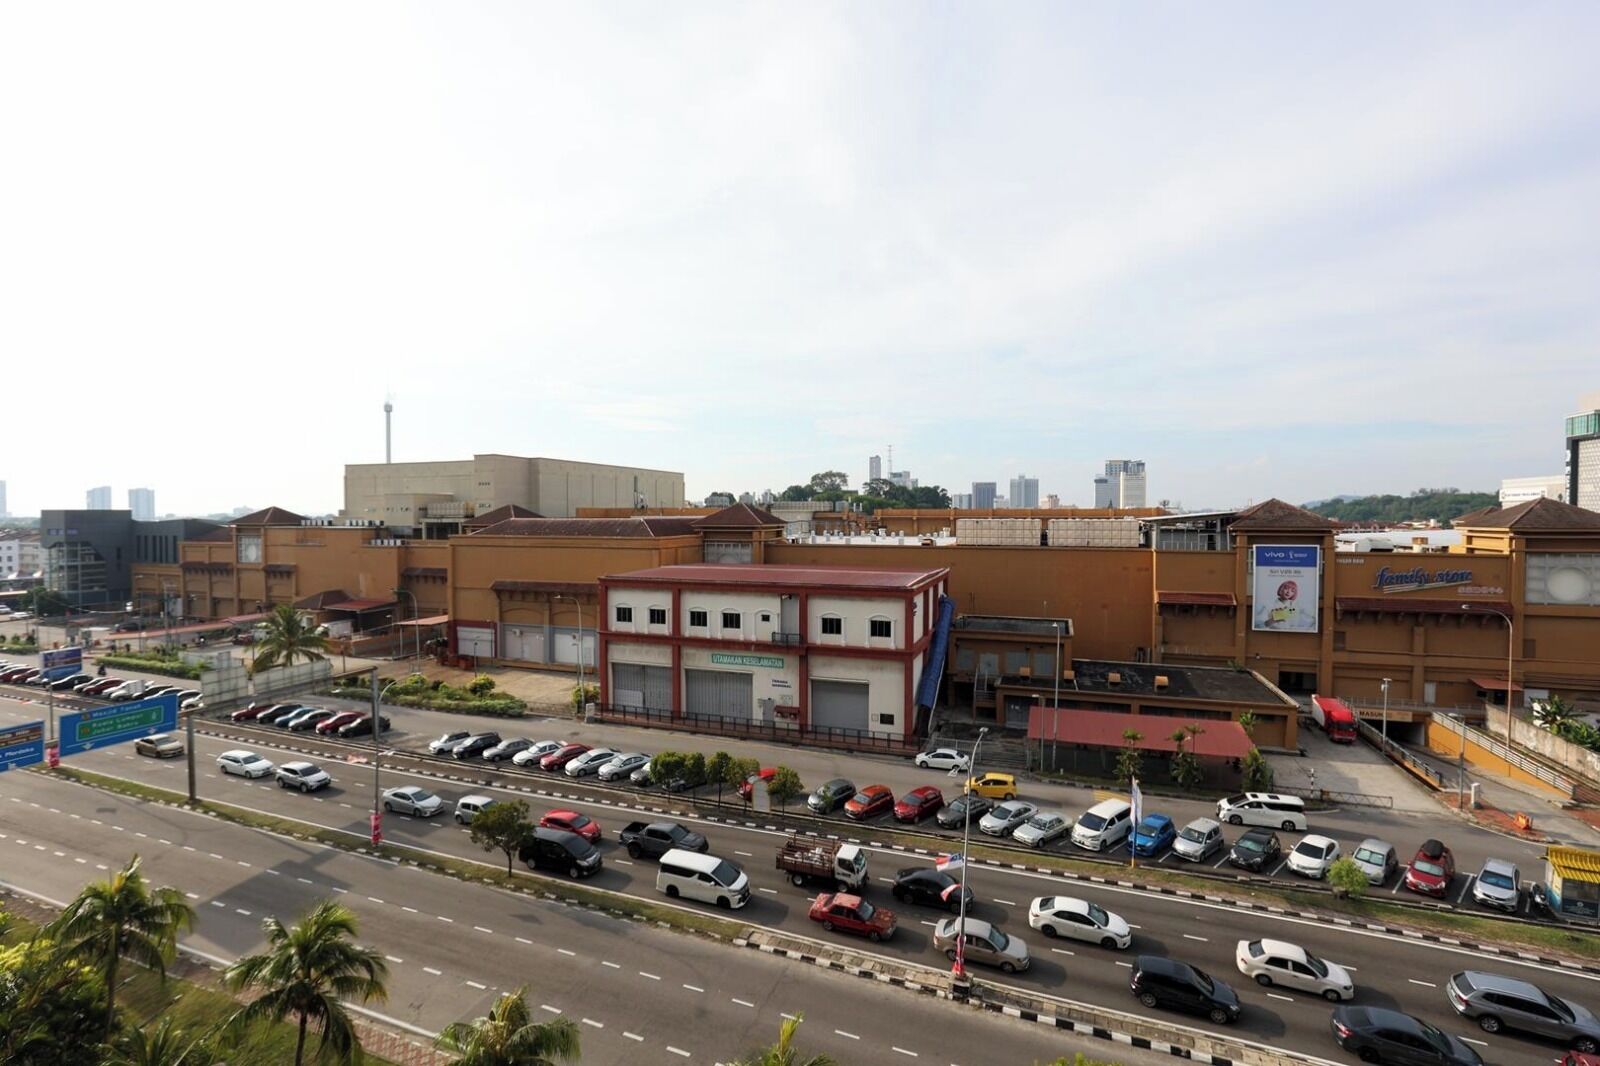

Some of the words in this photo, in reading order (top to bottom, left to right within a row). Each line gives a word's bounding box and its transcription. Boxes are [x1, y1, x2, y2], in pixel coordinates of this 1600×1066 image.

[1376, 566, 1429, 587] family
[1435, 569, 1472, 583] store
[713, 655, 743, 664] UTAMAKAN
[743, 657, 783, 667] KESELAMATAN
